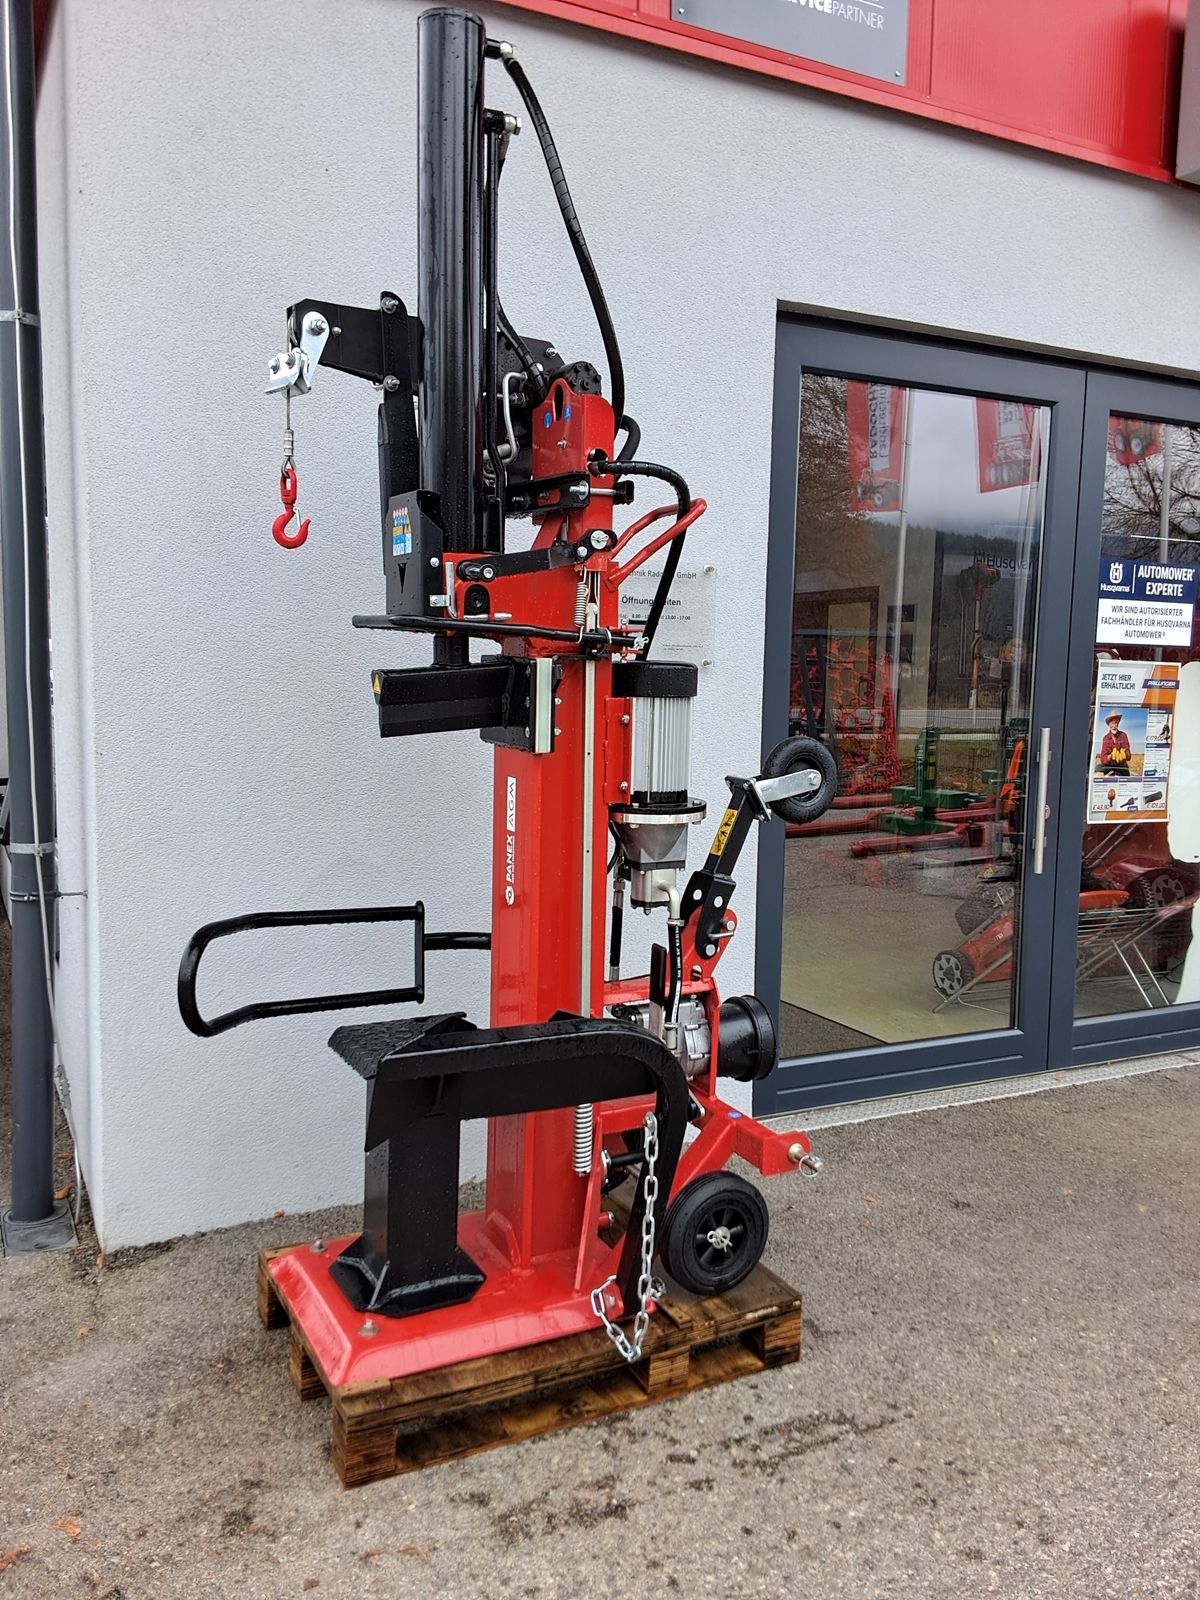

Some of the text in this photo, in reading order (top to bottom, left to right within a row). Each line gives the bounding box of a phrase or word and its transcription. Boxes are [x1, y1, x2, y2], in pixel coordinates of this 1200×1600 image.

[1100, 583, 1130, 592] Husqvarna
[1145, 581, 1184, 597] EXPERTE
[1111, 605, 1183, 617] WIR SIND AUTORISIERTER
[1101, 616, 1191, 628] FACHHÄNDLER FÜR HUSQVARNA
[1101, 673, 1132, 682] JETZT HIER
[1100, 681, 1135, 690] ERHÄLTLICH!
